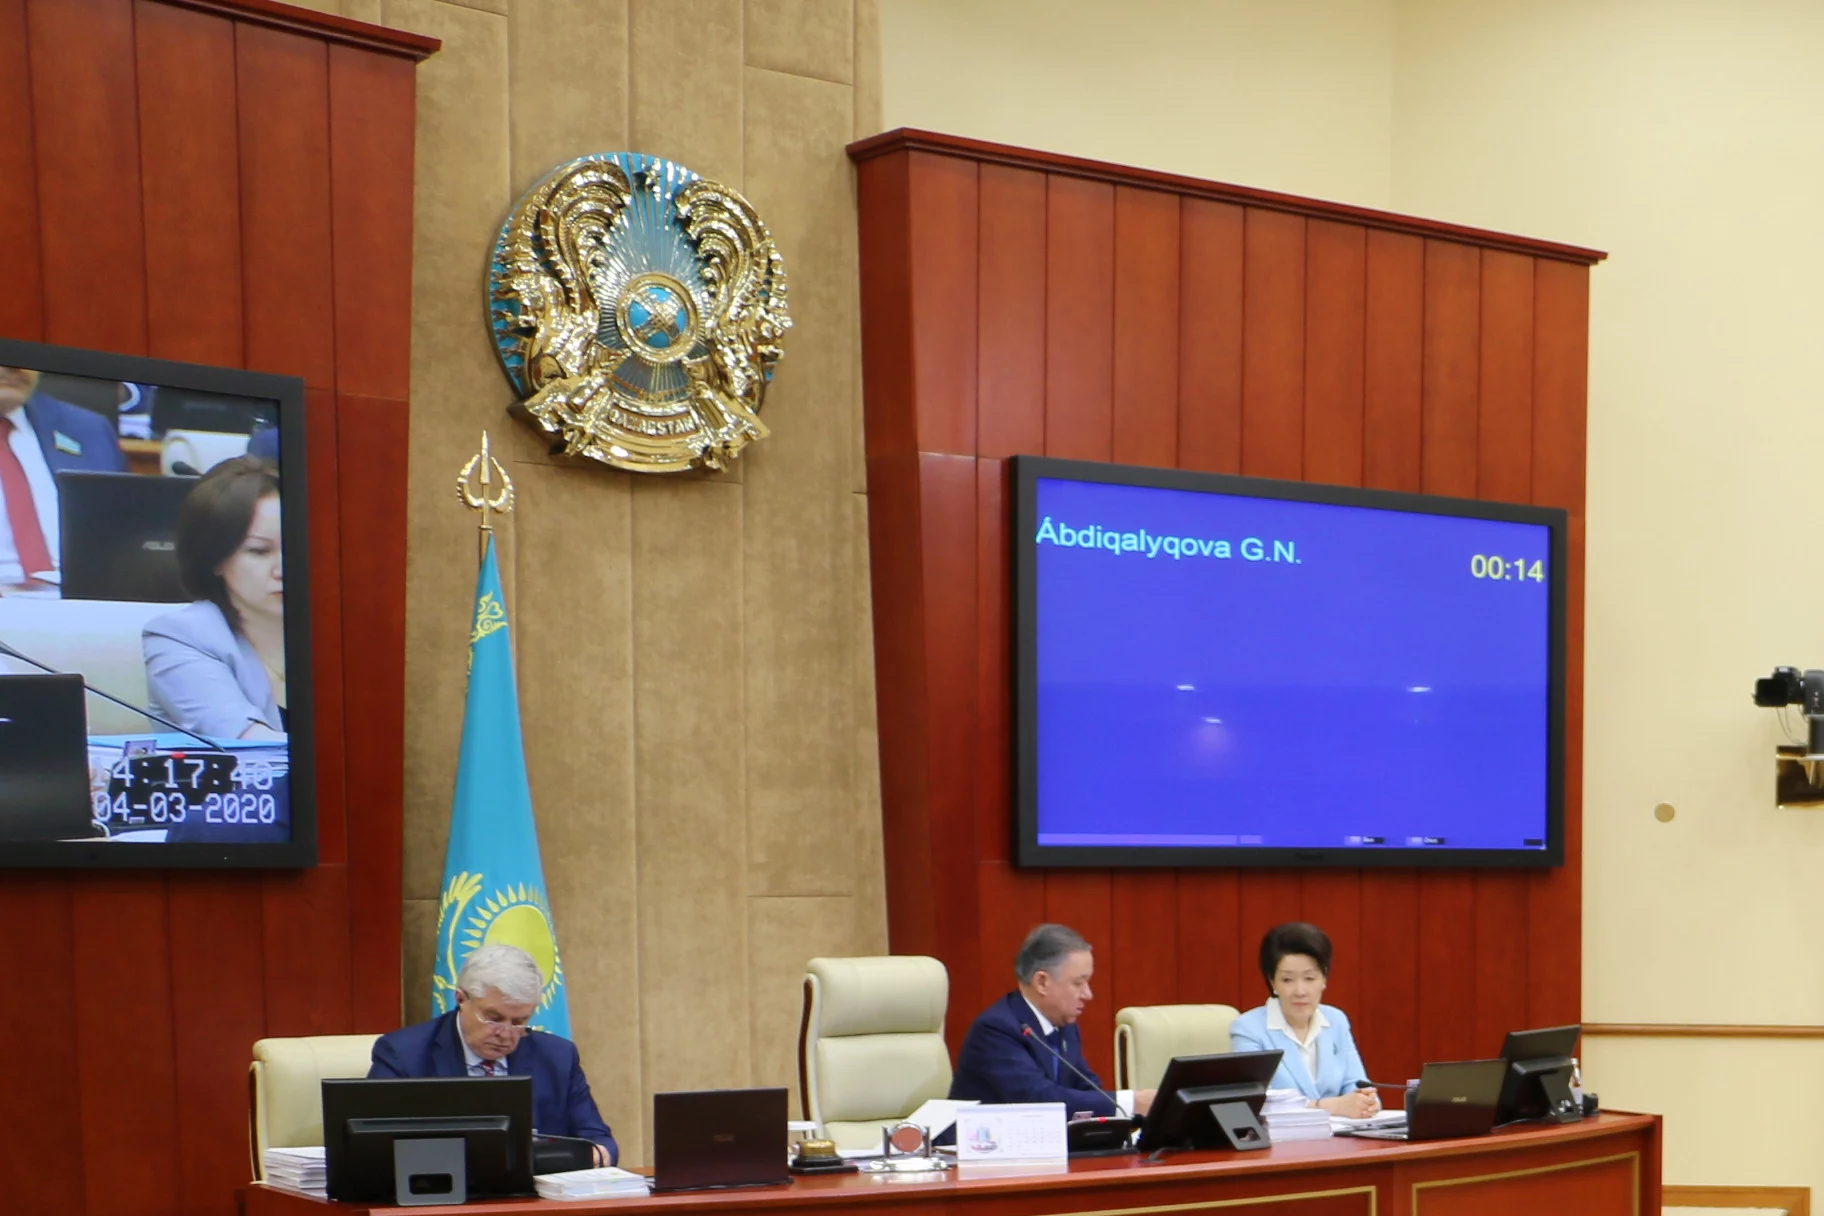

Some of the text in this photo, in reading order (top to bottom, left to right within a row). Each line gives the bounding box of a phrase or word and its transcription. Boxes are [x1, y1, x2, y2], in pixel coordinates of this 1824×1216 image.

[1036, 516, 1301, 564] Ábdiqalyqova G.N.
[1471, 554, 1544, 583] 00:14
[95, 791, 276, 823] 04-03-2020
